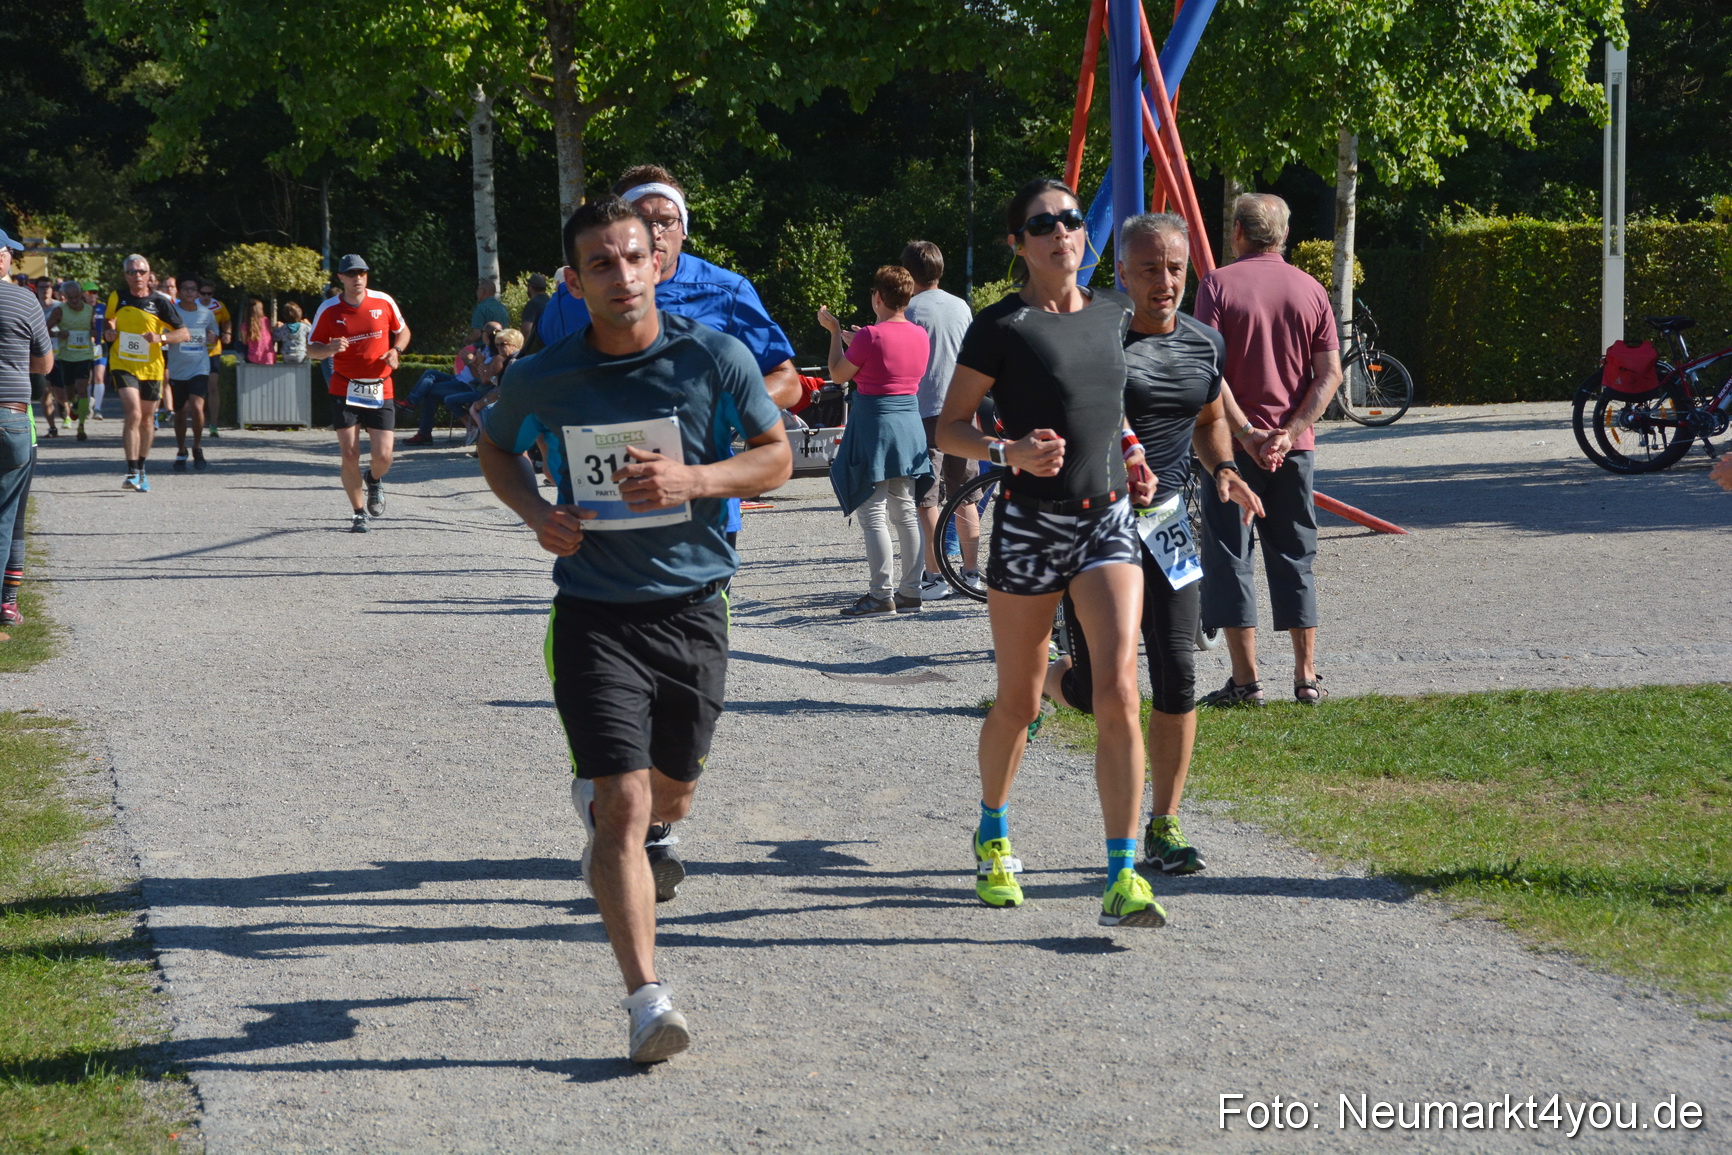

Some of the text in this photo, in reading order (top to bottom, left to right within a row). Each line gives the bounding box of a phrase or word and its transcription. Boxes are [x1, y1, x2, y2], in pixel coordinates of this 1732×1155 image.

[128, 341, 140, 350] 86
[353, 383, 379, 395] 2118
[595, 430, 645, 446] BOCK
[585, 448, 661, 485] 31
